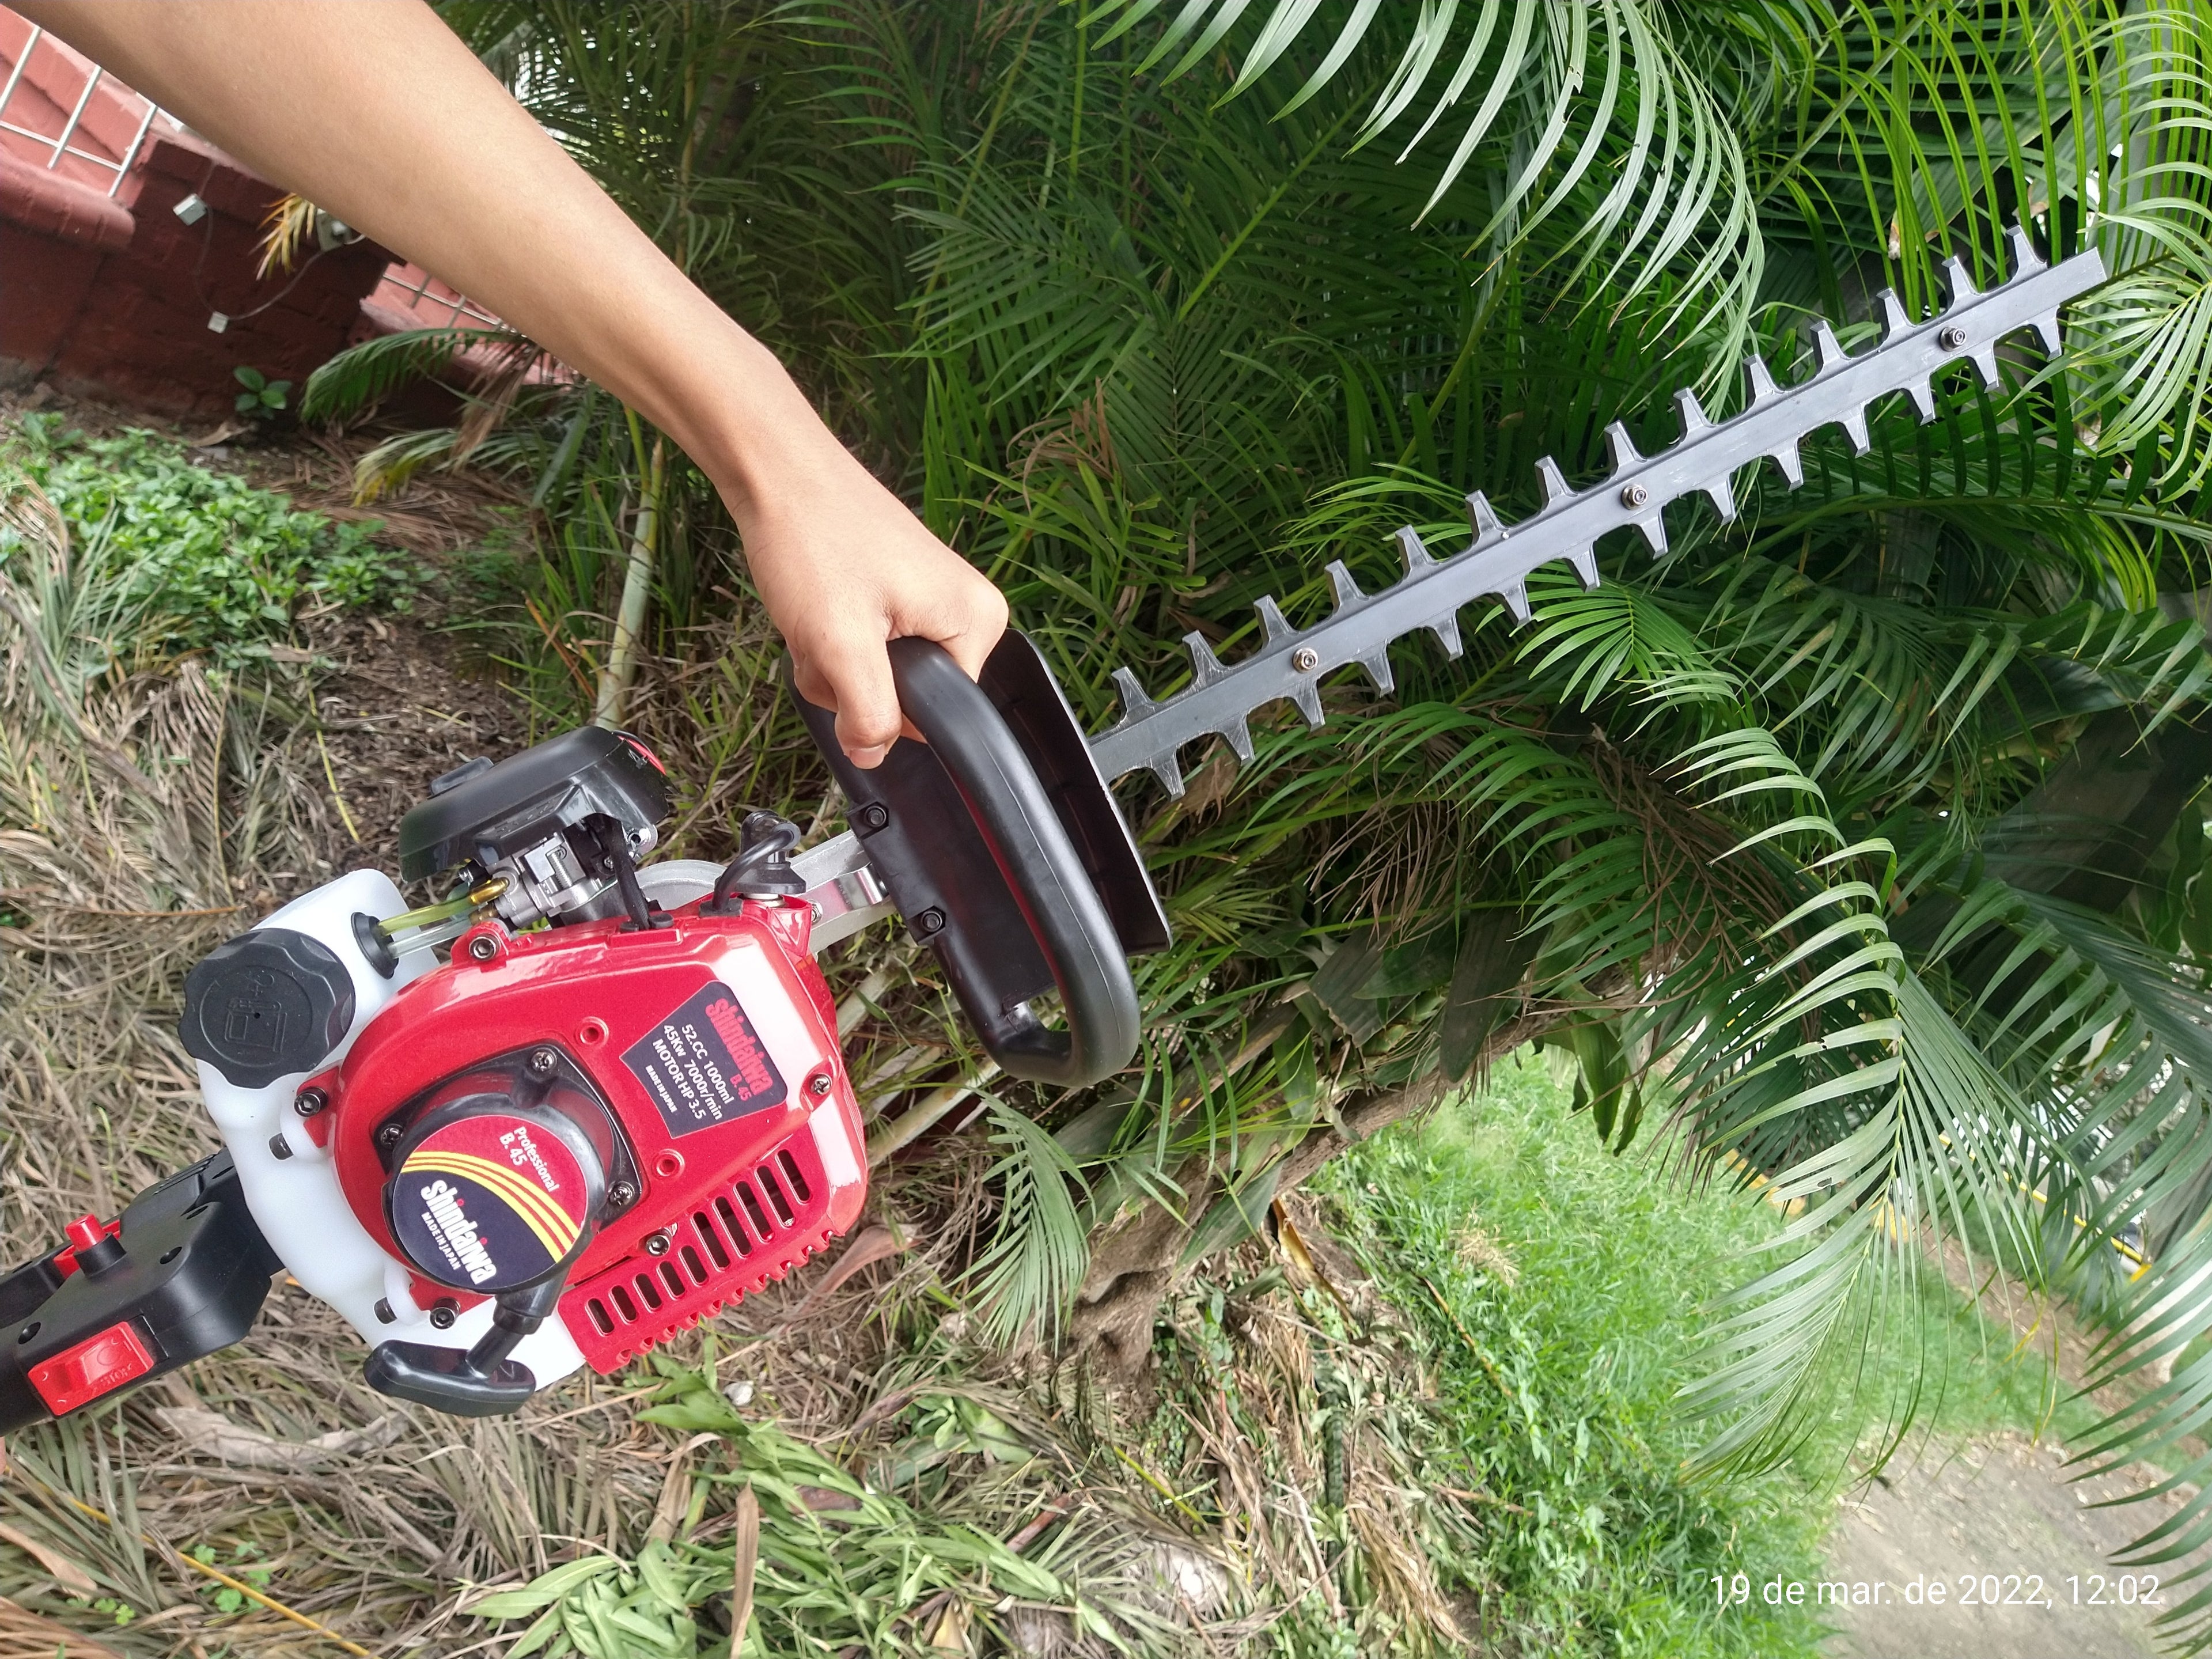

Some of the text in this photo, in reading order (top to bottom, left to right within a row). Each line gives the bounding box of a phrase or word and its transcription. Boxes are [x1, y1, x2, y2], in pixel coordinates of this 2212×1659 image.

[646, 1065, 677, 1113] MADE IN JAPAN
[653, 1039, 707, 1119] MOTOR HP 3.5
[664, 1025, 723, 1120] 45Kw 7000r/min
[681, 1024, 734, 1104] 52.CC 1000ml
[738, 1086, 752, 1101] 45
[499, 1132, 528, 1166] B. 45
[514, 1126, 560, 1192] Professional
[421, 1211, 461, 1270] MADE IN JAPAN
